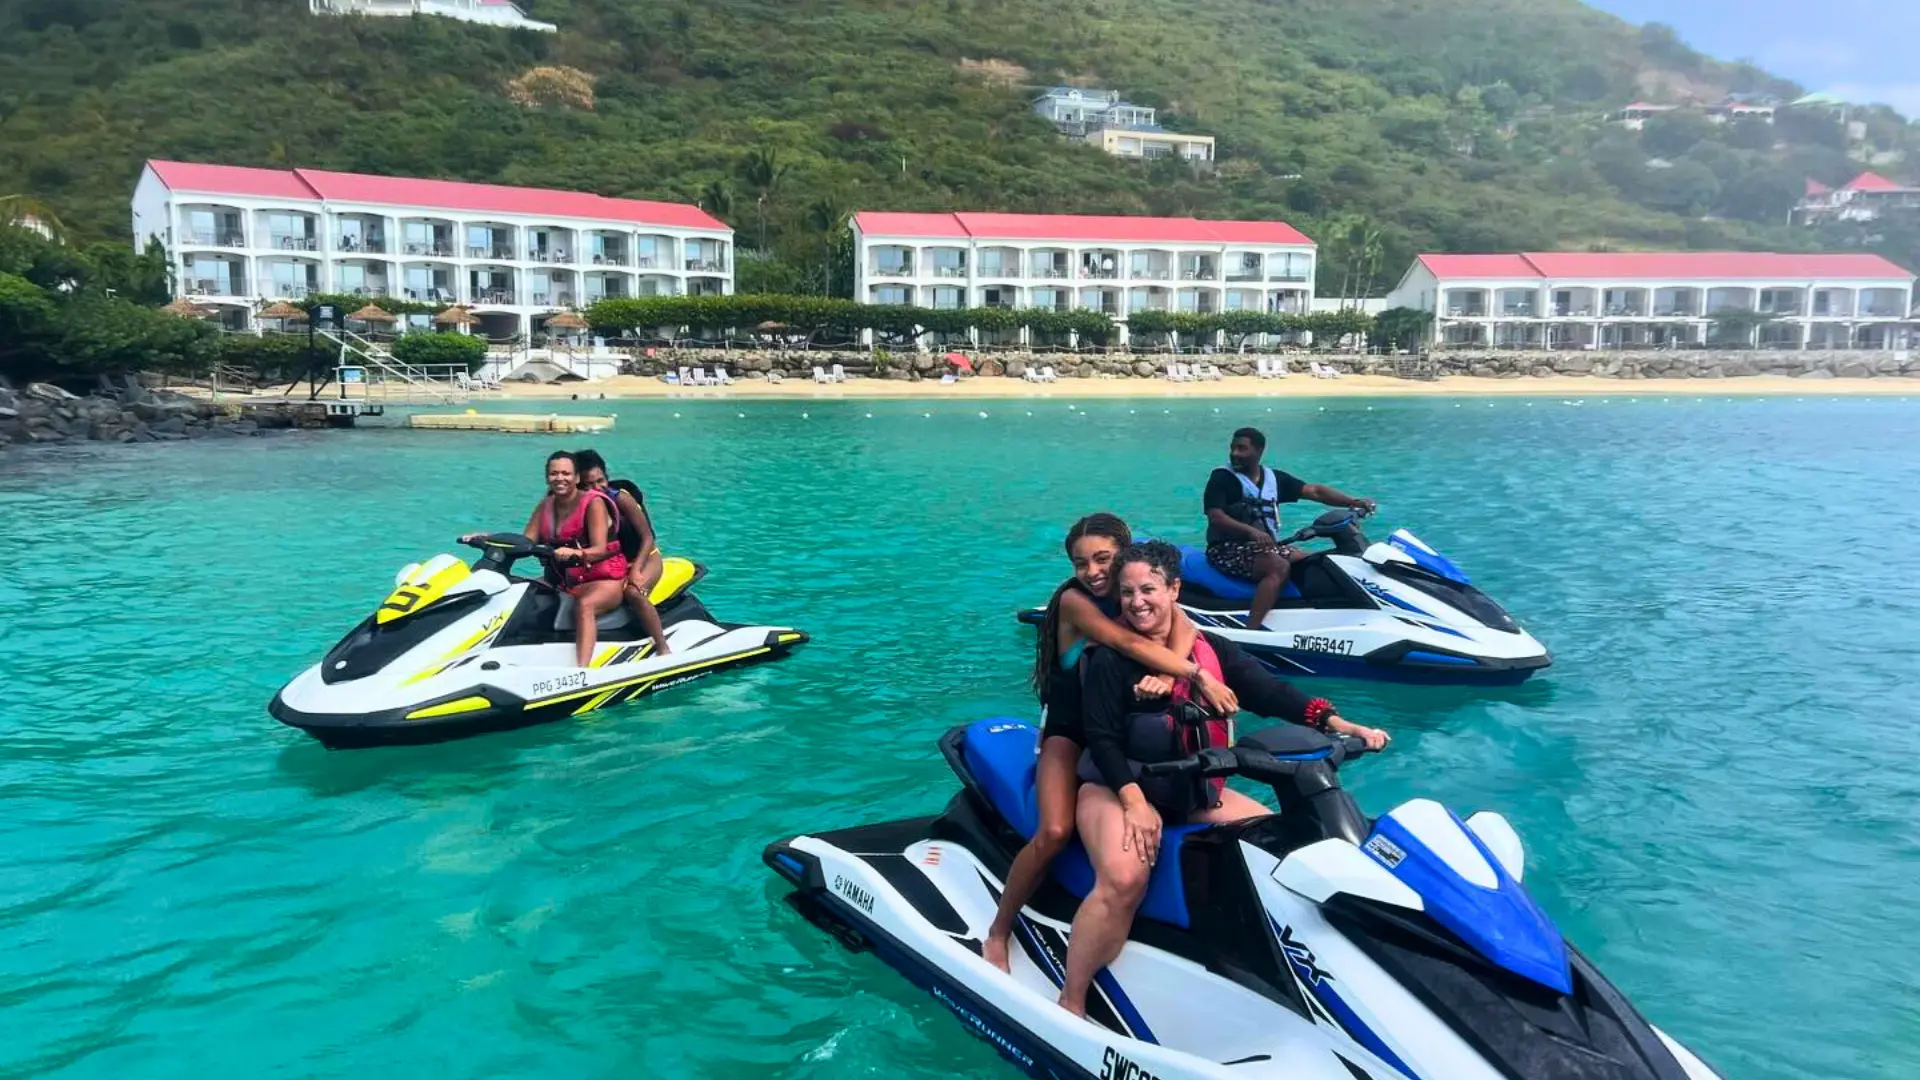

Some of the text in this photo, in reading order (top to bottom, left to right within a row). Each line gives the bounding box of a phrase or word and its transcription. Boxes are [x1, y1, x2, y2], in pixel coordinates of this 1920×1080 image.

[1293, 634, 1354, 655] SWG63447
[532, 671, 589, 695] PPG 34322
[843, 878, 875, 915] YAMAHA
[1279, 924, 1336, 985] VX
[1100, 1045, 1162, 1080] SWG
